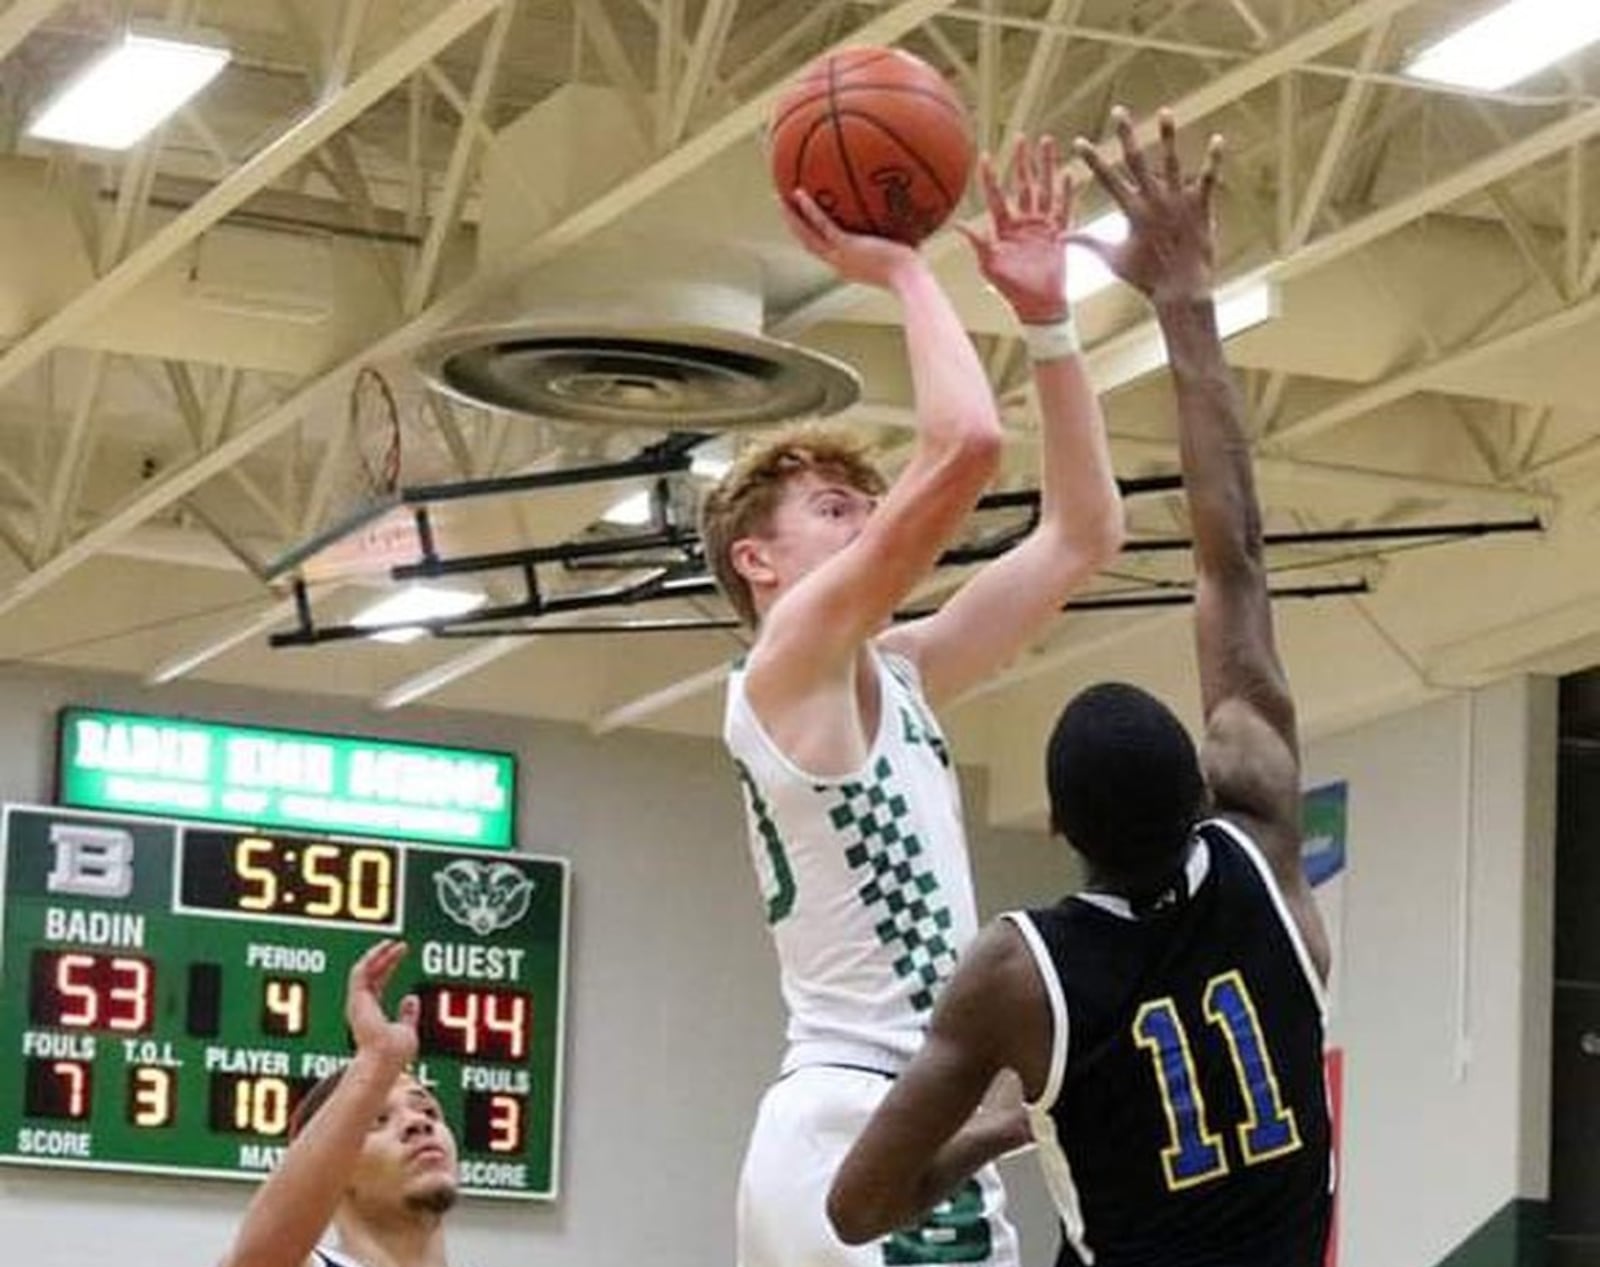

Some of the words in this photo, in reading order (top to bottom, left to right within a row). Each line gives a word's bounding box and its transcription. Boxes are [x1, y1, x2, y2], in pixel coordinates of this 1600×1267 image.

[47, 824, 135, 898] B
[236, 837, 391, 921] 5:50
[45, 907, 145, 947] BADIN
[246, 943, 326, 974] PERIOD
[421, 941, 526, 981] GUEST
[57, 954, 149, 1031] 53
[265, 981, 303, 1033] 4
[22, 1031, 96, 1060] FOULS
[437, 989, 526, 1057] 44
[205, 1045, 291, 1077] PLAYER
[462, 1065, 531, 1095] FOULS
[1131, 968, 1304, 1193] 11
[53, 1061, 84, 1117] 7
[135, 1067, 170, 1127] 3
[235, 1077, 289, 1136] 10
[17, 1128, 92, 1157] SCORE
[489, 1095, 521, 1152] 3
[459, 1159, 529, 1188] SCORE
